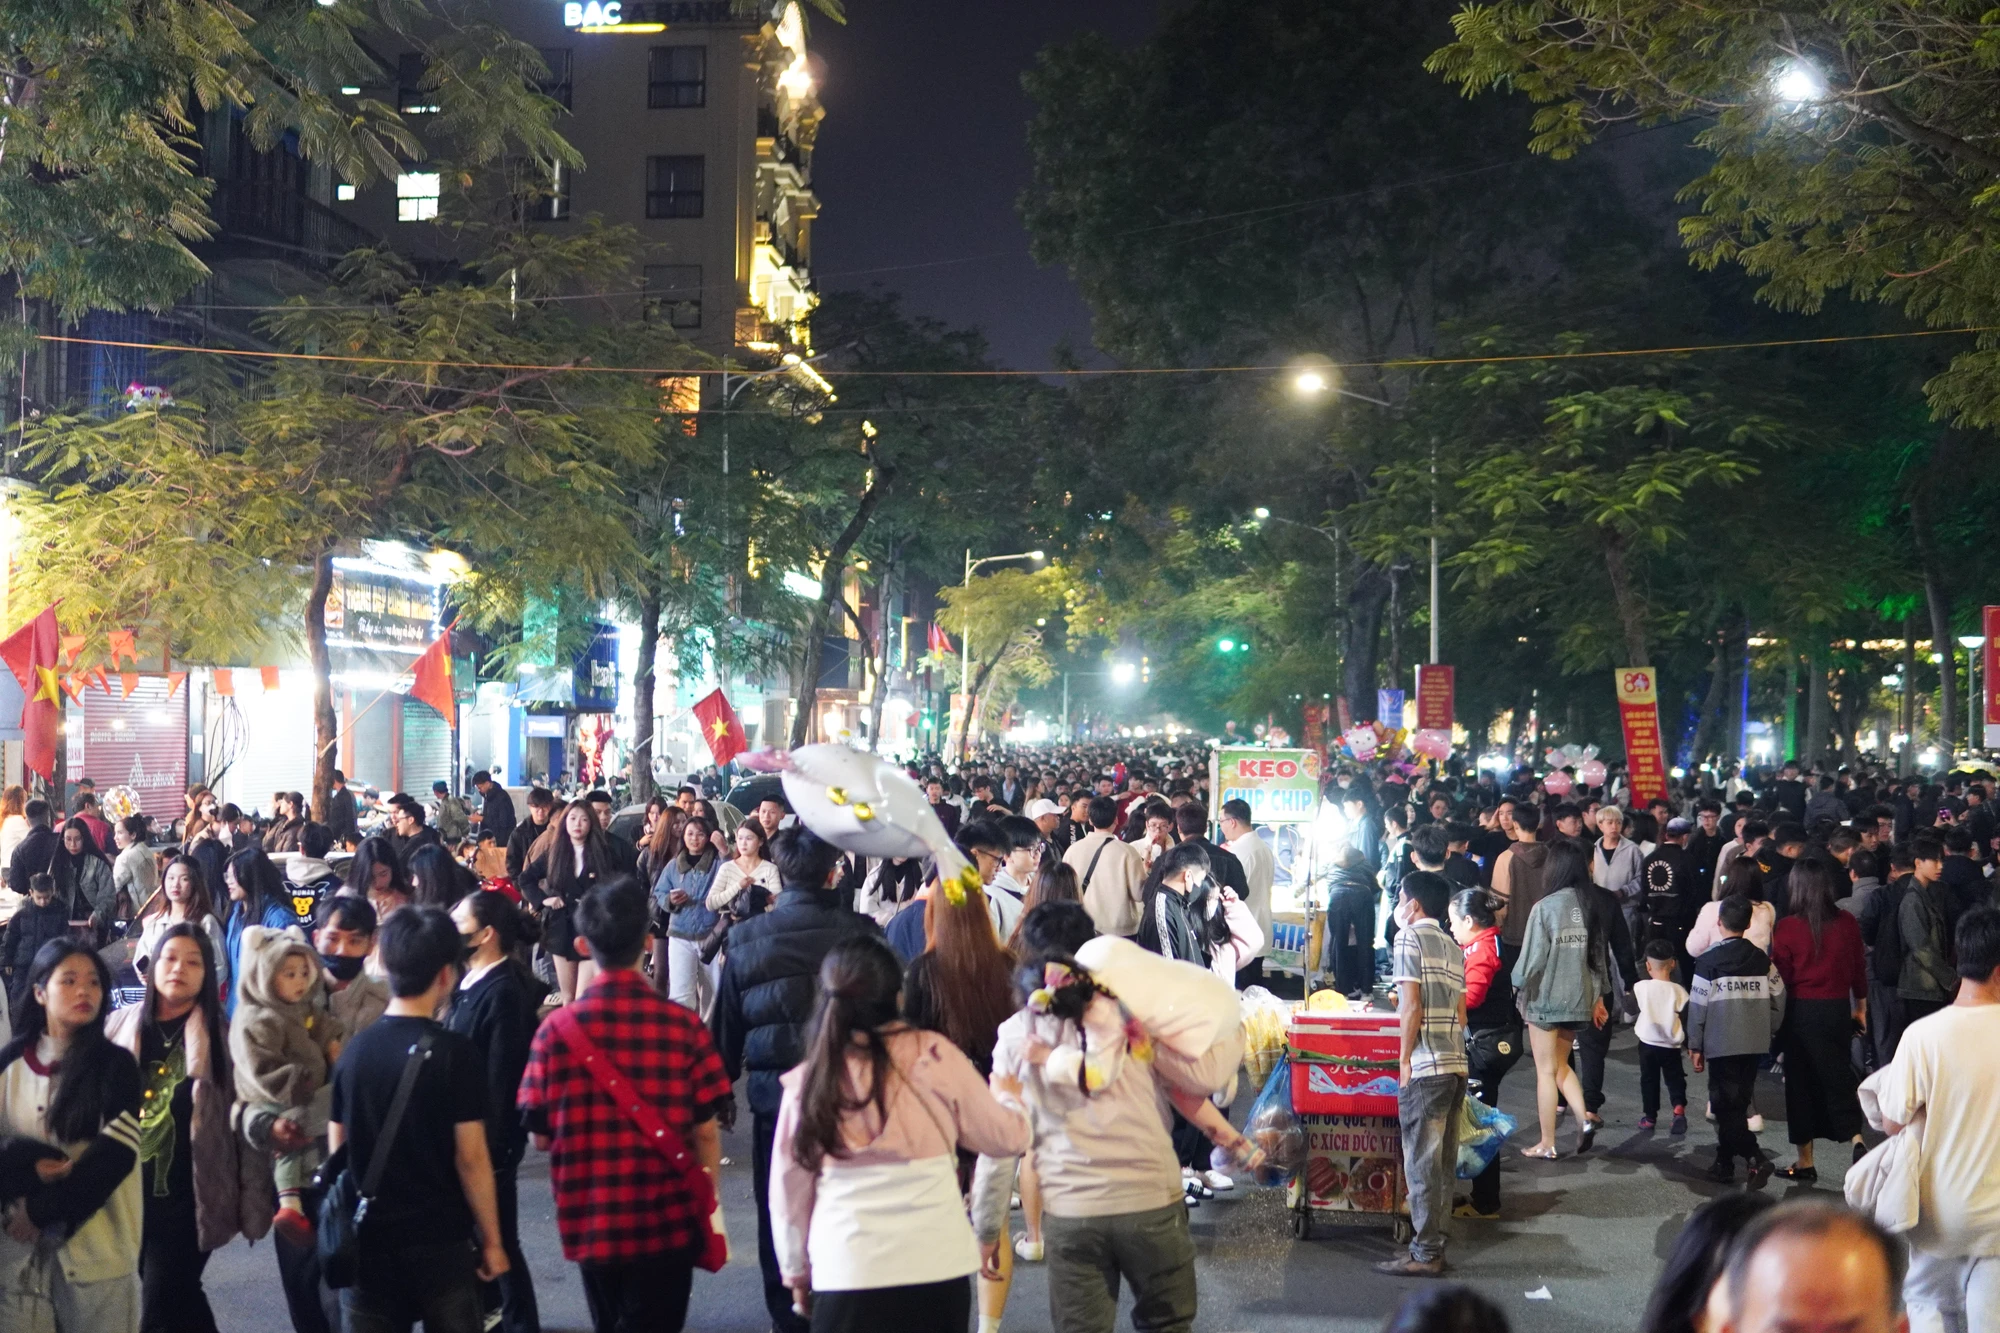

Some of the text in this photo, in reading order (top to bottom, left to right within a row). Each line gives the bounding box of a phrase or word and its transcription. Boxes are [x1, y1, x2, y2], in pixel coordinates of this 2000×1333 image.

[564, 1, 622, 26] BAC
[1238, 759, 1298, 782] KẸO
[1270, 788, 1313, 812] CHIP
[1271, 921, 1306, 953] HIP
[1716, 981, 1761, 992] X-GAMER
[1321, 1130, 1350, 1151] XÍCH
[1353, 1130, 1378, 1152] ĐỨC
